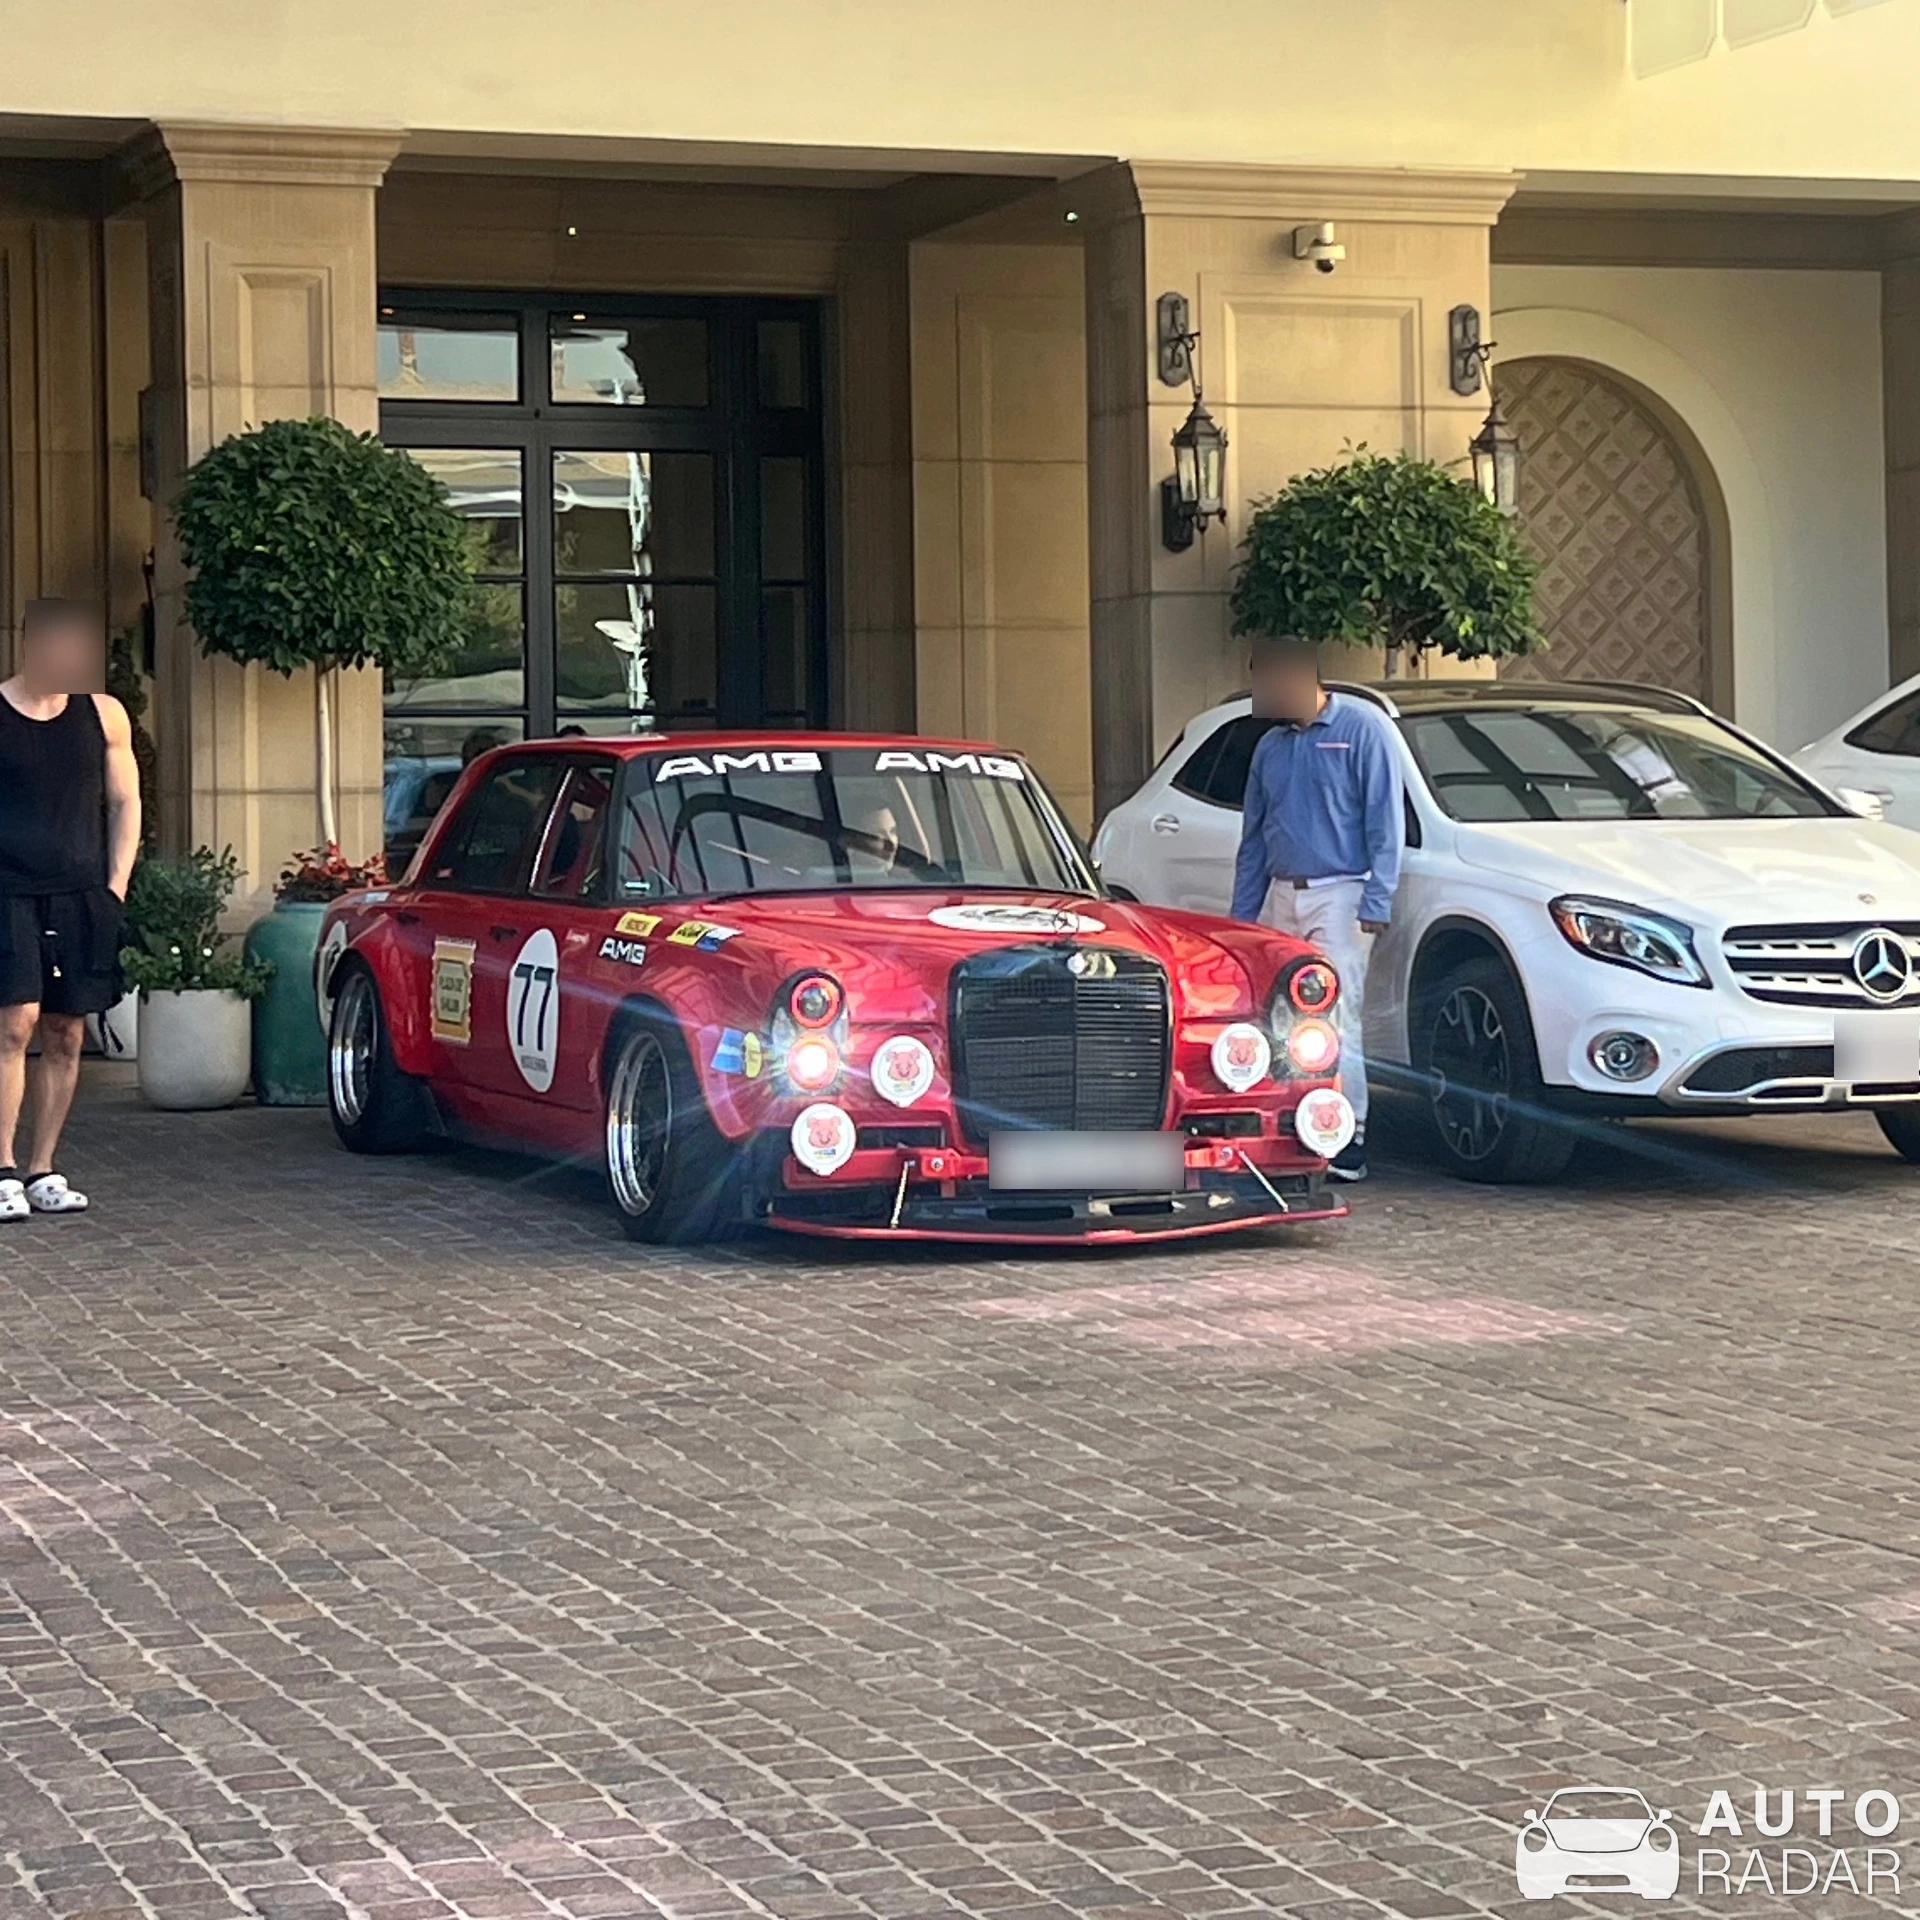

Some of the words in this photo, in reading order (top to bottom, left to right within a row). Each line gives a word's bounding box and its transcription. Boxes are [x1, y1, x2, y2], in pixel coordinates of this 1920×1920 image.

[655, 751, 823, 782] AMG
[875, 751, 1025, 781] AMG
[599, 937, 647, 965] AMG
[514, 962, 555, 1051] 77
